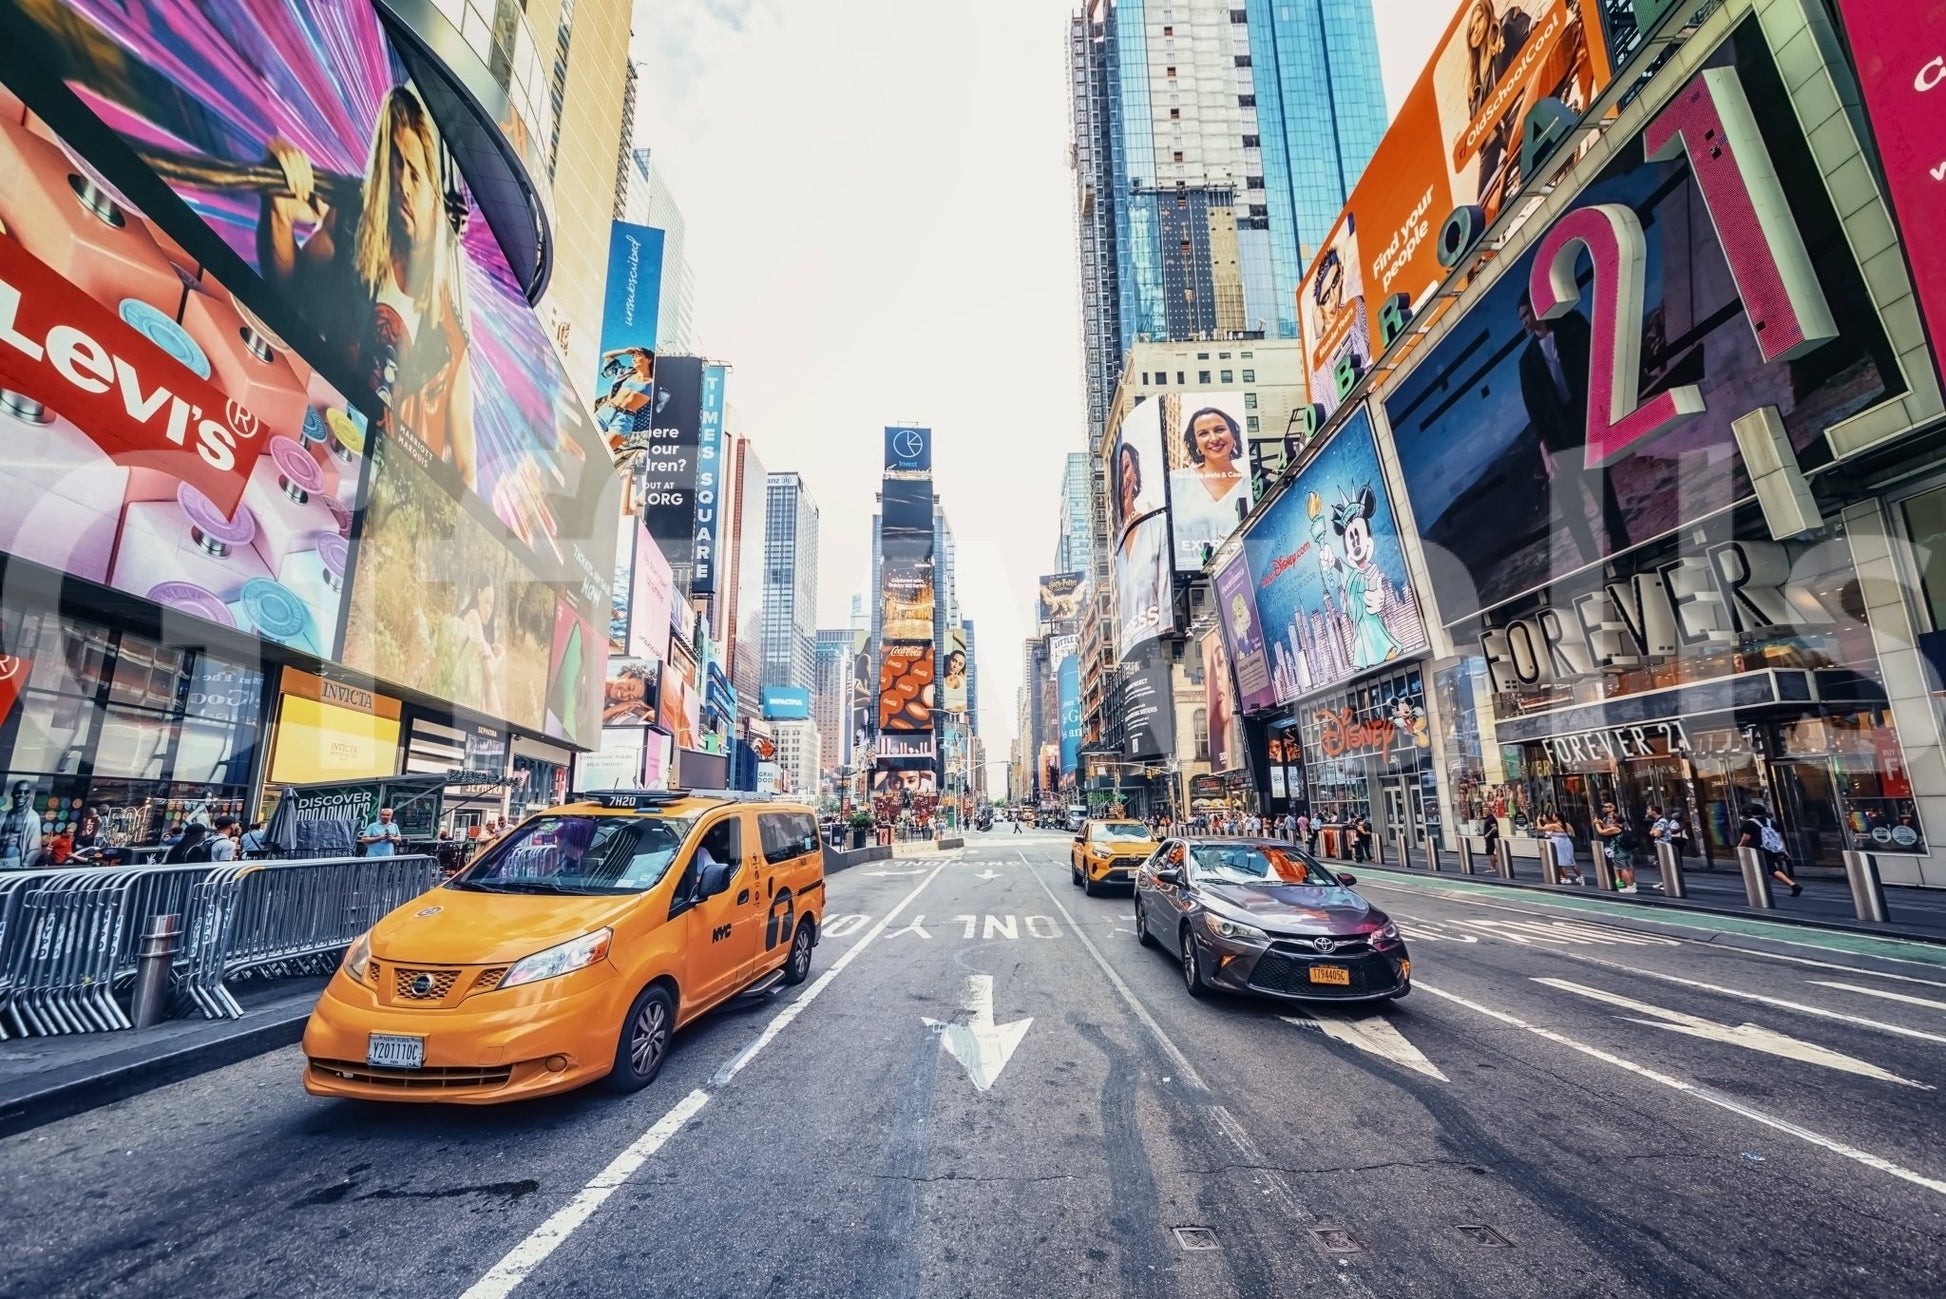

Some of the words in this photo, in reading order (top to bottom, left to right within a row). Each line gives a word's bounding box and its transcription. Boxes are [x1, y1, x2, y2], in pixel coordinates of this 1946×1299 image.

[1372, 231, 1400, 280] Find
[1400, 184, 1435, 246] your
[1382, 219, 1429, 293] people
[624, 234, 642, 327] unsubscribed
[702, 377, 720, 460] TIMES
[398, 435, 428, 468] MARQUIS
[400, 423, 433, 461] MARRIOTT
[899, 459, 918, 468] Invest
[663, 481, 675, 489] AT
[696, 472, 714, 579] SQUARE
[1478, 540, 1790, 693] FOREVER
[1054, 637, 1074, 649] LITTLE
[322, 681, 373, 709] INVICTA
[477, 726, 498, 738] SEPHORA
[1541, 727, 1653, 764] FOREVER
[1657, 720, 1693, 754] 21
[330, 742, 358, 754] INVICTA
[298, 791, 372, 809] DISCOVER
[608, 796, 637, 807] 7H20
[202, 905, 214, 942] NYPD
[712, 923, 732, 944] NYC
[884, 914, 1064, 940] ONLY
[373, 1042, 419, 1060] Y201110C
